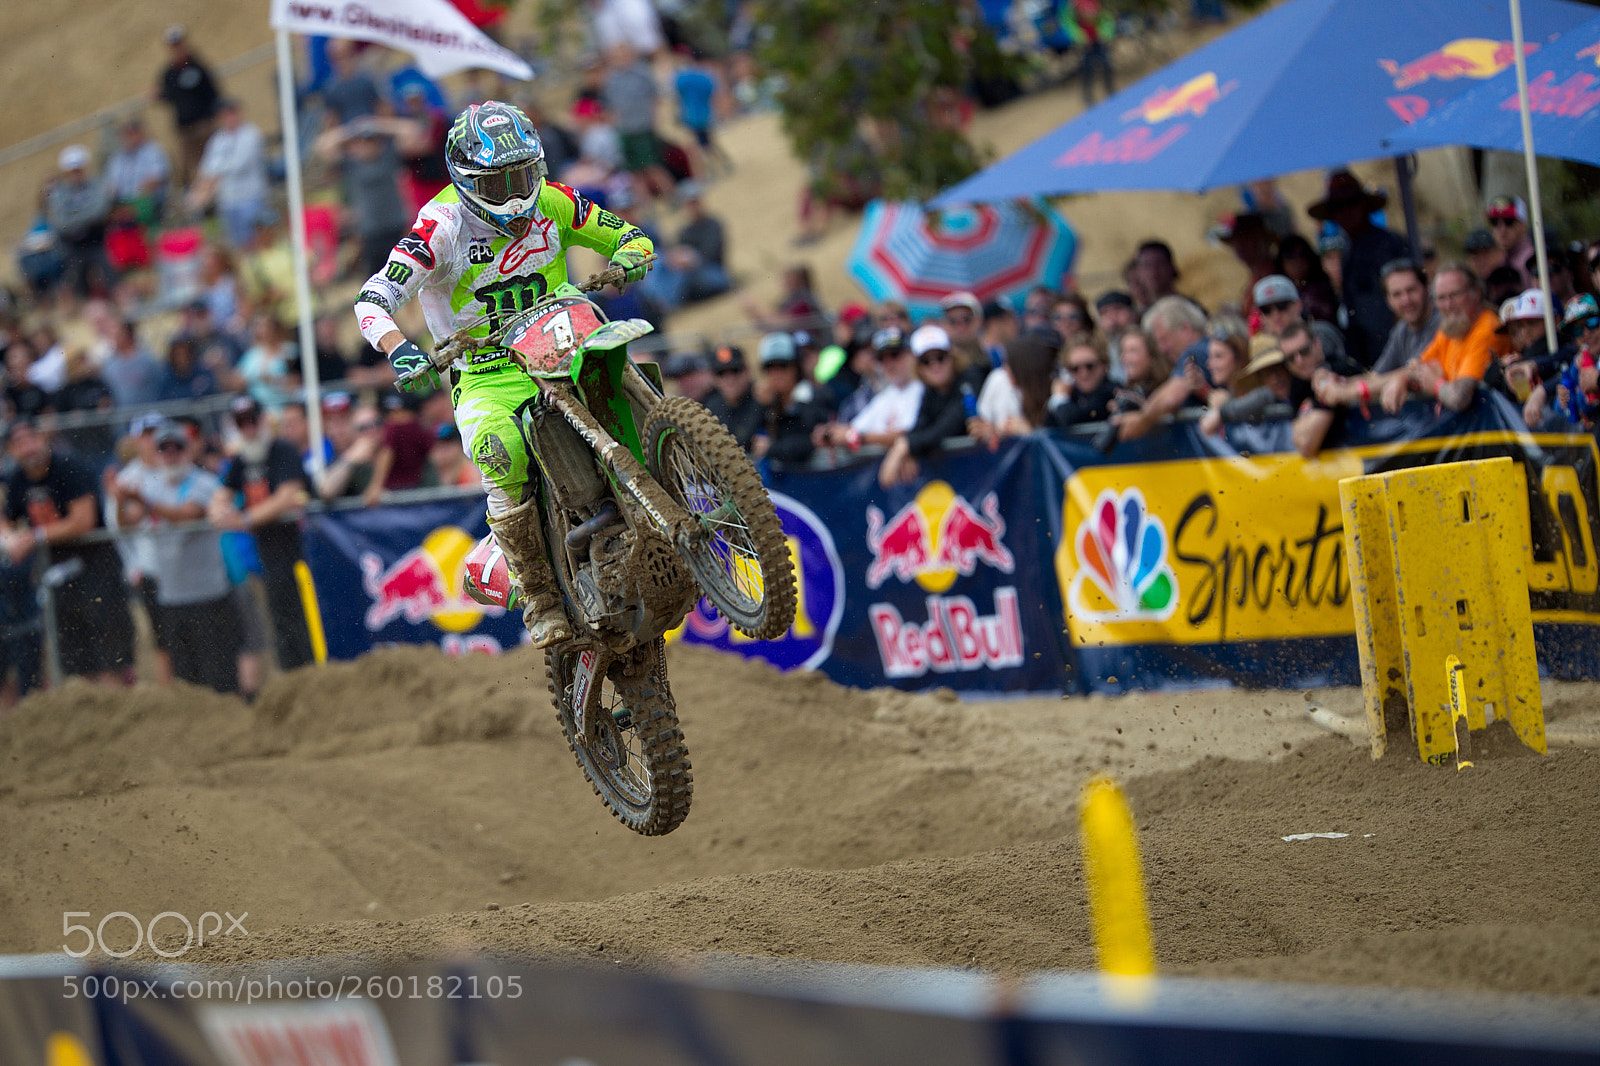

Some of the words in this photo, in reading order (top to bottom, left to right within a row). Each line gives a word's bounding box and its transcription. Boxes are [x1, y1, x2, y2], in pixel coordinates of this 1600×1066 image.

[486, 116, 505, 125] BELL
[493, 148, 537, 164] MONSTER
[525, 309, 549, 328] LUCAS
[549, 302, 563, 313] OIL
[541, 308, 576, 352] 1
[625, 477, 669, 527] DUNLOP
[480, 543, 504, 586] 1
[1173, 490, 1352, 644] Sports
[484, 588, 503, 599] TOMAC
[868, 595, 958, 679] Red
[940, 586, 1025, 673] Bull
[573, 673, 587, 718] RENTHAL
